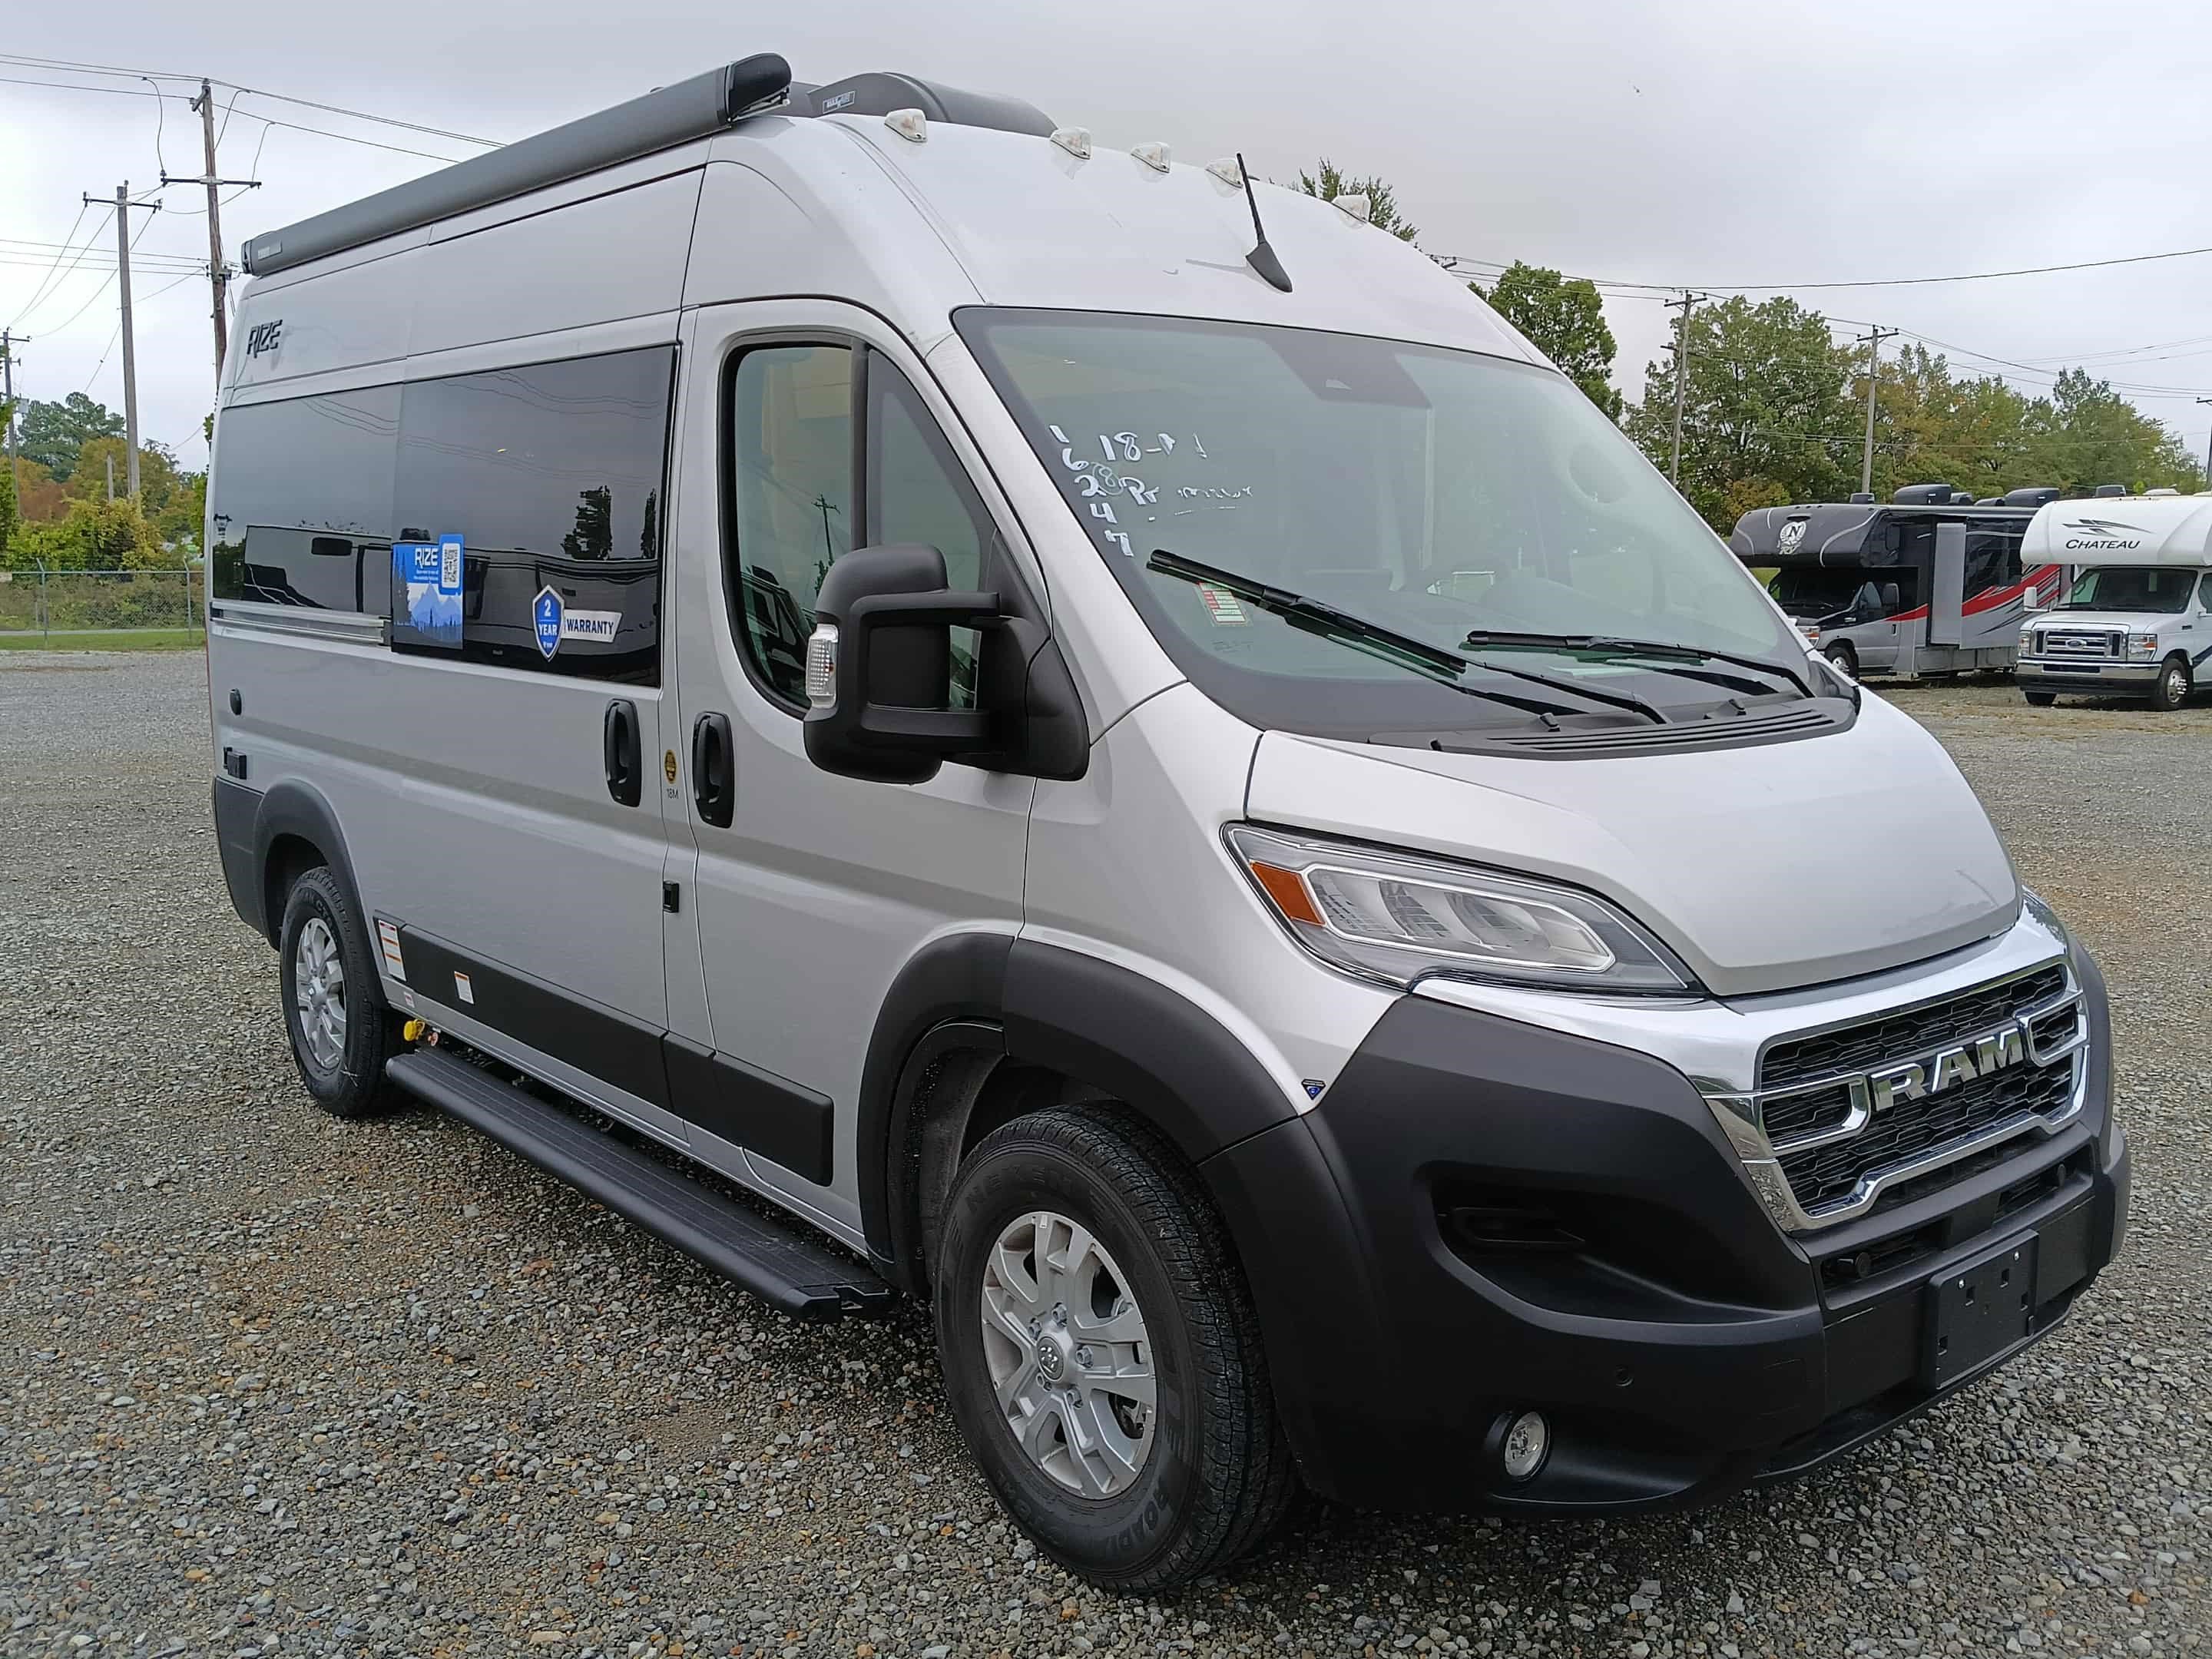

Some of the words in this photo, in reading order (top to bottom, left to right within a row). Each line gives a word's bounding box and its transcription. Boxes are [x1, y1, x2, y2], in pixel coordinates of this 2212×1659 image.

[247, 320, 283, 359] RIZE
[2065, 538, 2141, 550] CHATEAU
[415, 547, 439, 568] RIZE
[544, 599, 552, 617] 2
[538, 624, 558, 636] YEAR
[566, 618, 614, 635] WARRANTY
[1870, 1027, 2024, 1112] RAM
